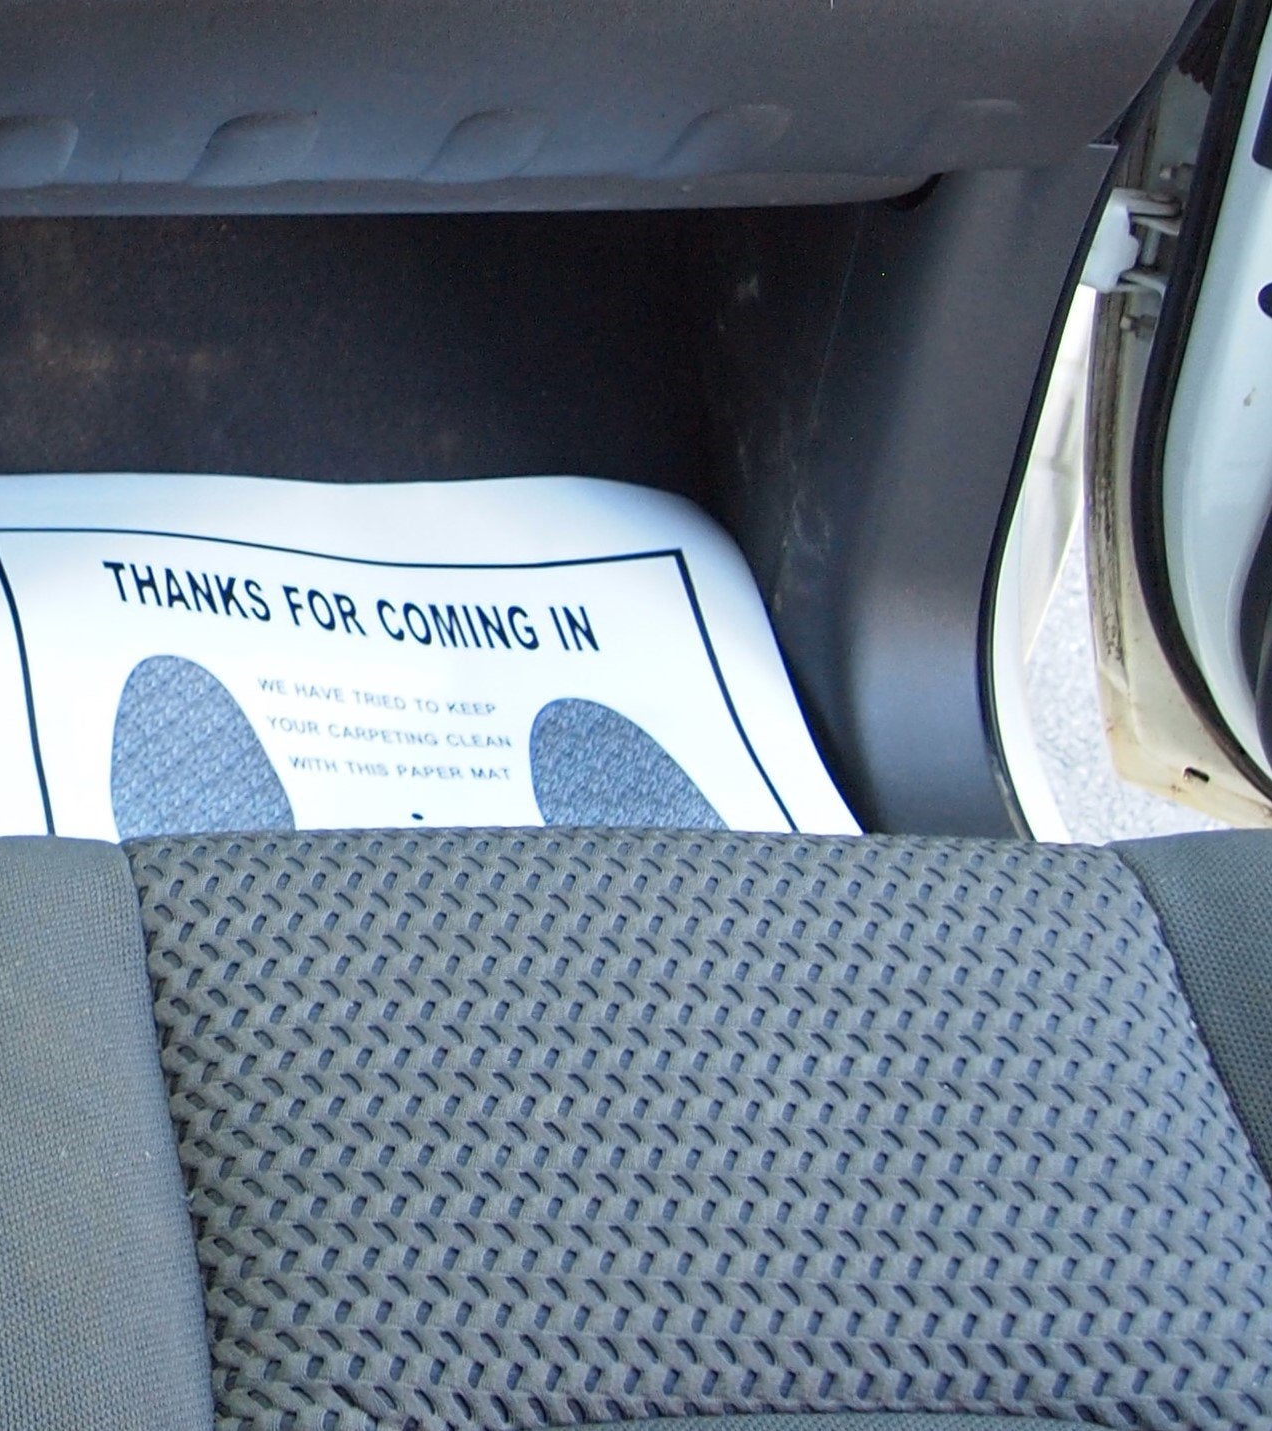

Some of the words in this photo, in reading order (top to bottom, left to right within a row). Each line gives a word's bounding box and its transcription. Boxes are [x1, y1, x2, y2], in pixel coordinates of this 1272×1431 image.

[102, 561, 272, 622] THANKS
[282, 585, 368, 638] FOR
[375, 597, 541, 651] COMING
[547, 605, 602, 652] IN
[257, 677, 286, 695] WE
[294, 681, 345, 704] HAVE
[351, 688, 406, 711] TRIED
[413, 697, 439, 715] TO
[446, 700, 497, 716] KEEP
[266, 714, 320, 736] YOUR
[328, 723, 439, 747] CARPETING
[446, 733, 513, 749] CLEAN
[288, 755, 337, 774] WITH
[345, 761, 389, 777] THIS
[396, 764, 462, 780] PAPER
[470, 766, 511, 781] MAT
